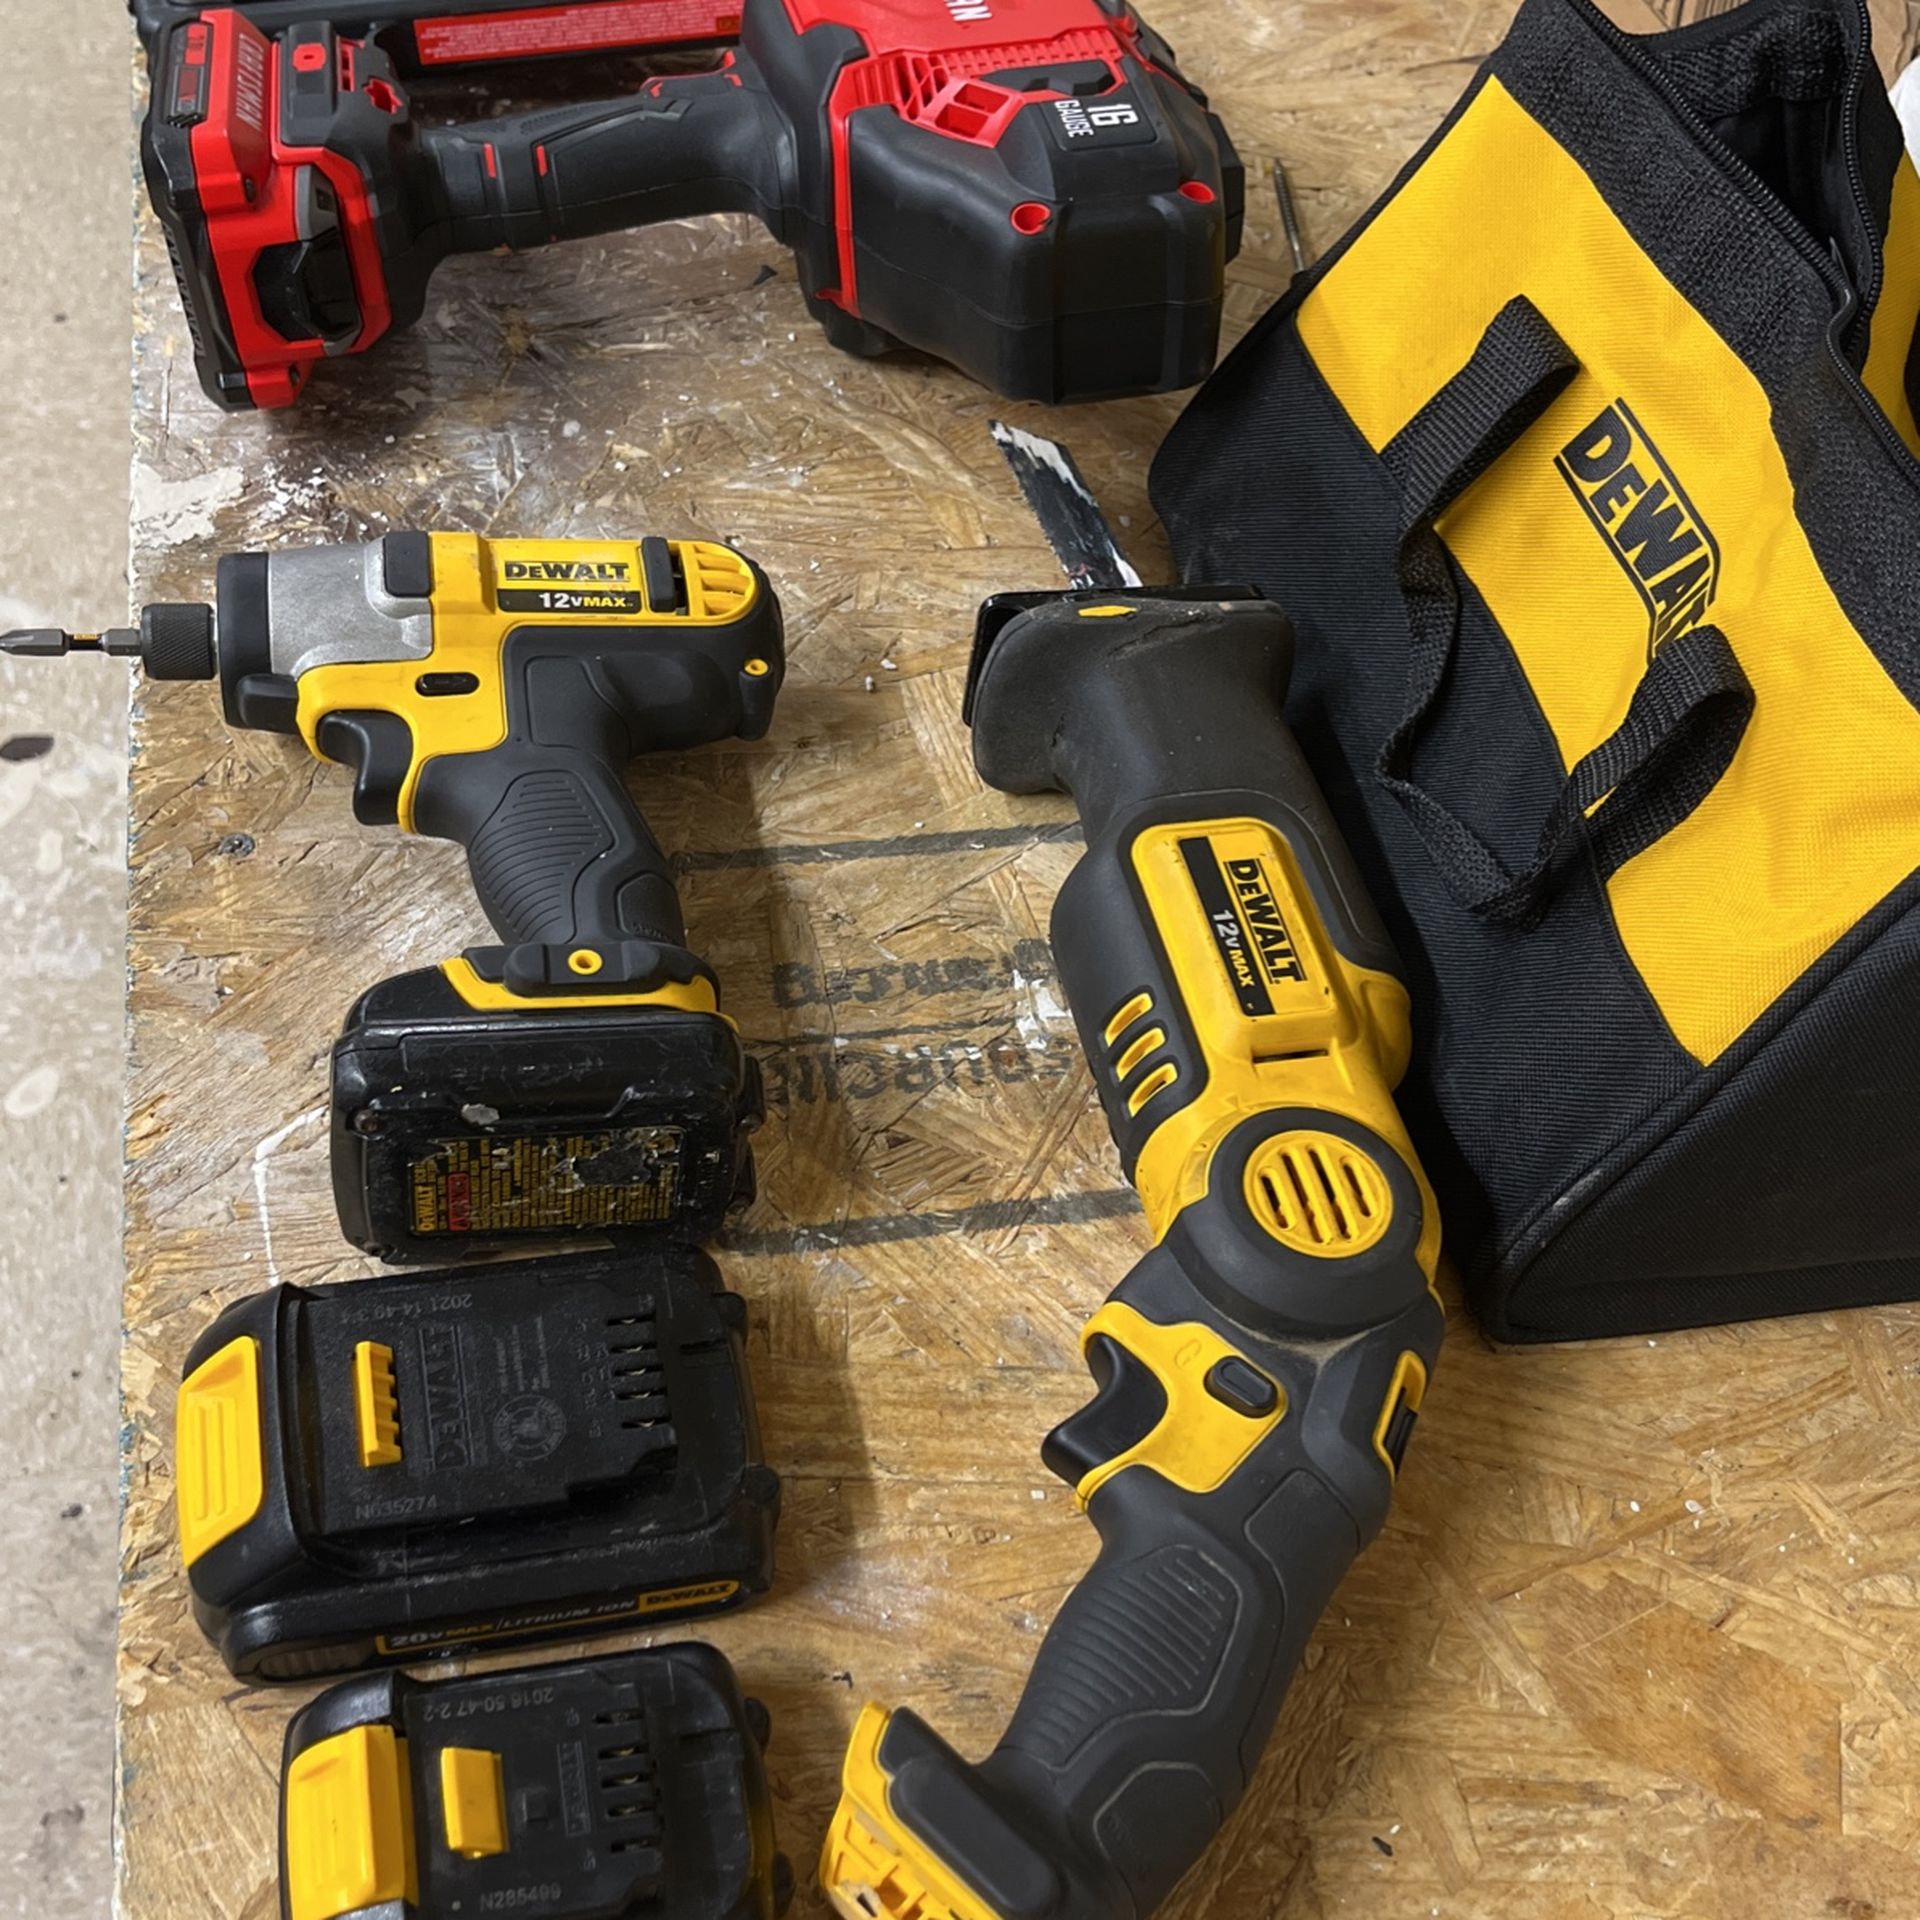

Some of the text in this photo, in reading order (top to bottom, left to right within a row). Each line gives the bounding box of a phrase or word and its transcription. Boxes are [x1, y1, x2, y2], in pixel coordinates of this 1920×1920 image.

[236, 33, 264, 132] CRAFTSMAN
[1055, 100, 1094, 138] GAUGE
[1086, 103, 1139, 127] 16
